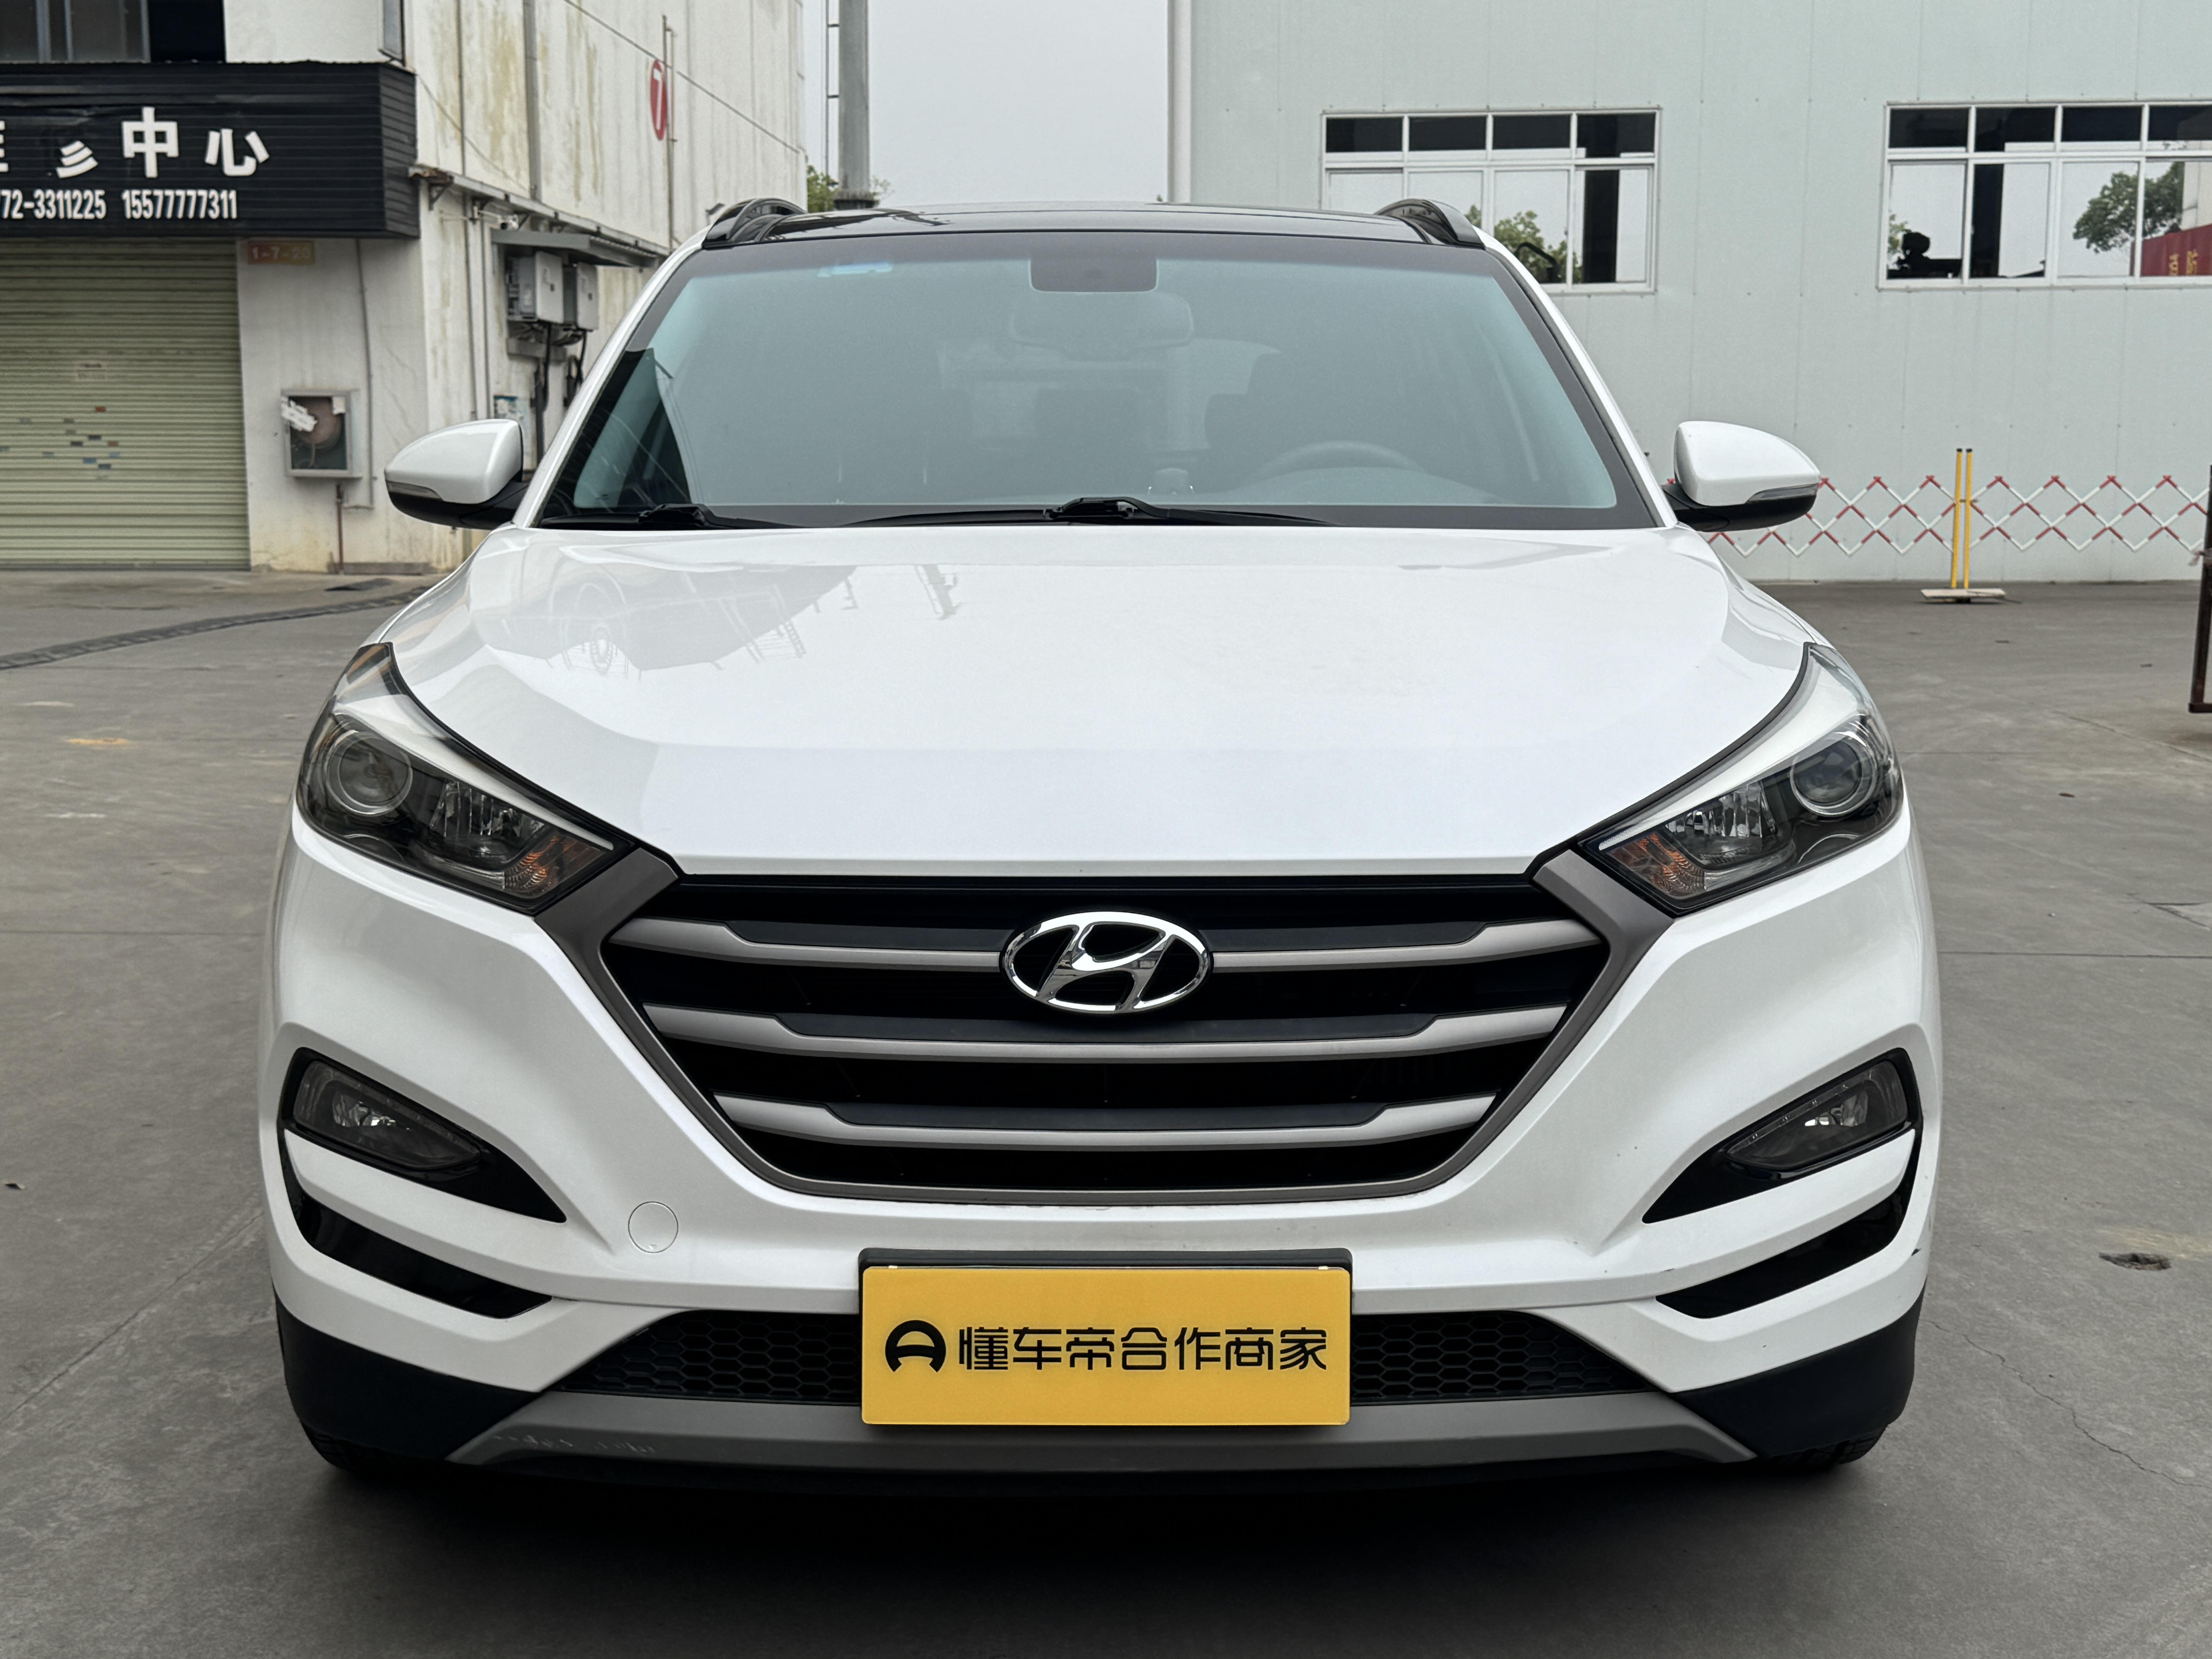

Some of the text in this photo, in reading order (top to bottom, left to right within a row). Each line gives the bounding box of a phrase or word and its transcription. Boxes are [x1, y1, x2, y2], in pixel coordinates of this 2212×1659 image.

[0, 189, 237, 219] 72-3311225 15577777311
[959, 1326, 1327, 1370] 懂车帝合作商家
